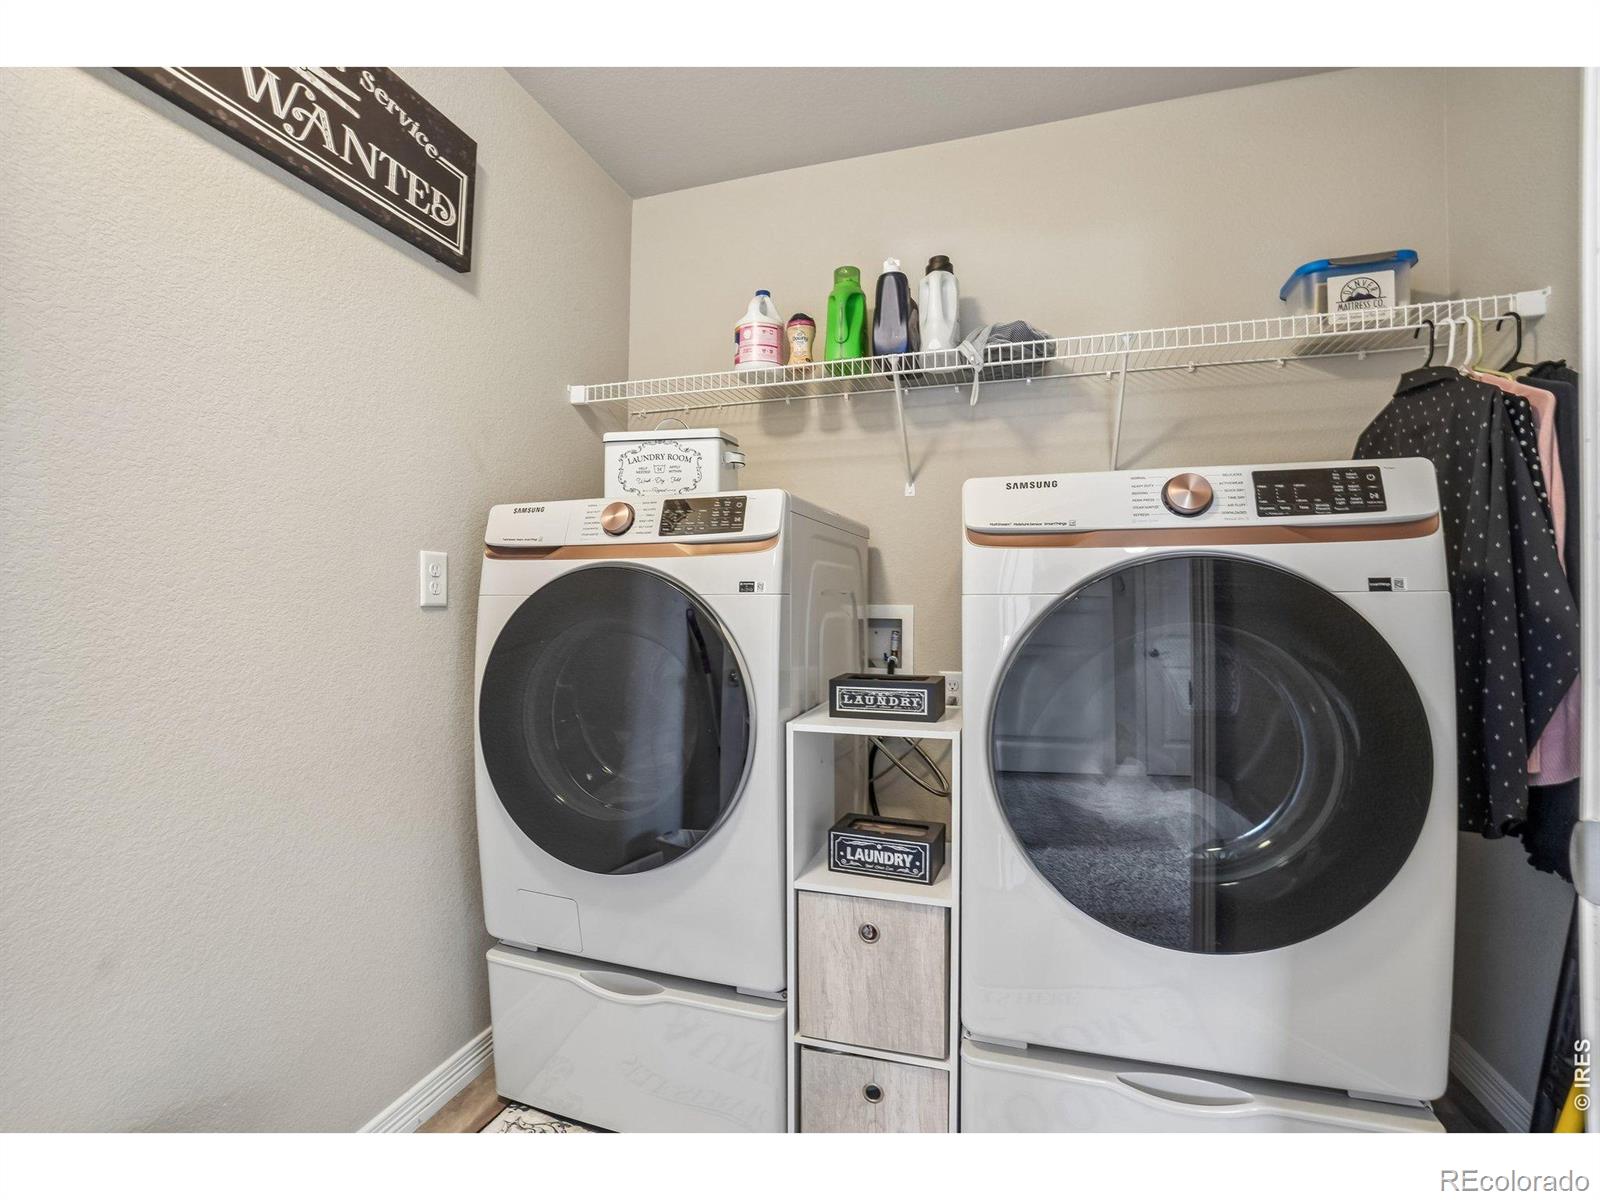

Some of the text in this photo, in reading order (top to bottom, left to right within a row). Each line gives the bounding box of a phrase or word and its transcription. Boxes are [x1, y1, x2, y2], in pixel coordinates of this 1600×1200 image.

[359, 69, 440, 159] Service
[240, 67, 457, 227] WANTED
[1343, 279, 1378, 295] DENVER
[1337, 300, 1371, 311] MATTRESS
[627, 453, 693, 465] LAUNDRY ROOM
[1006, 480, 1059, 490] SAMSUNG
[513, 506, 545, 514] SAMSUNG
[843, 694, 922, 707] LAUNDRY
[846, 846, 914, 868] LAUNDRY
